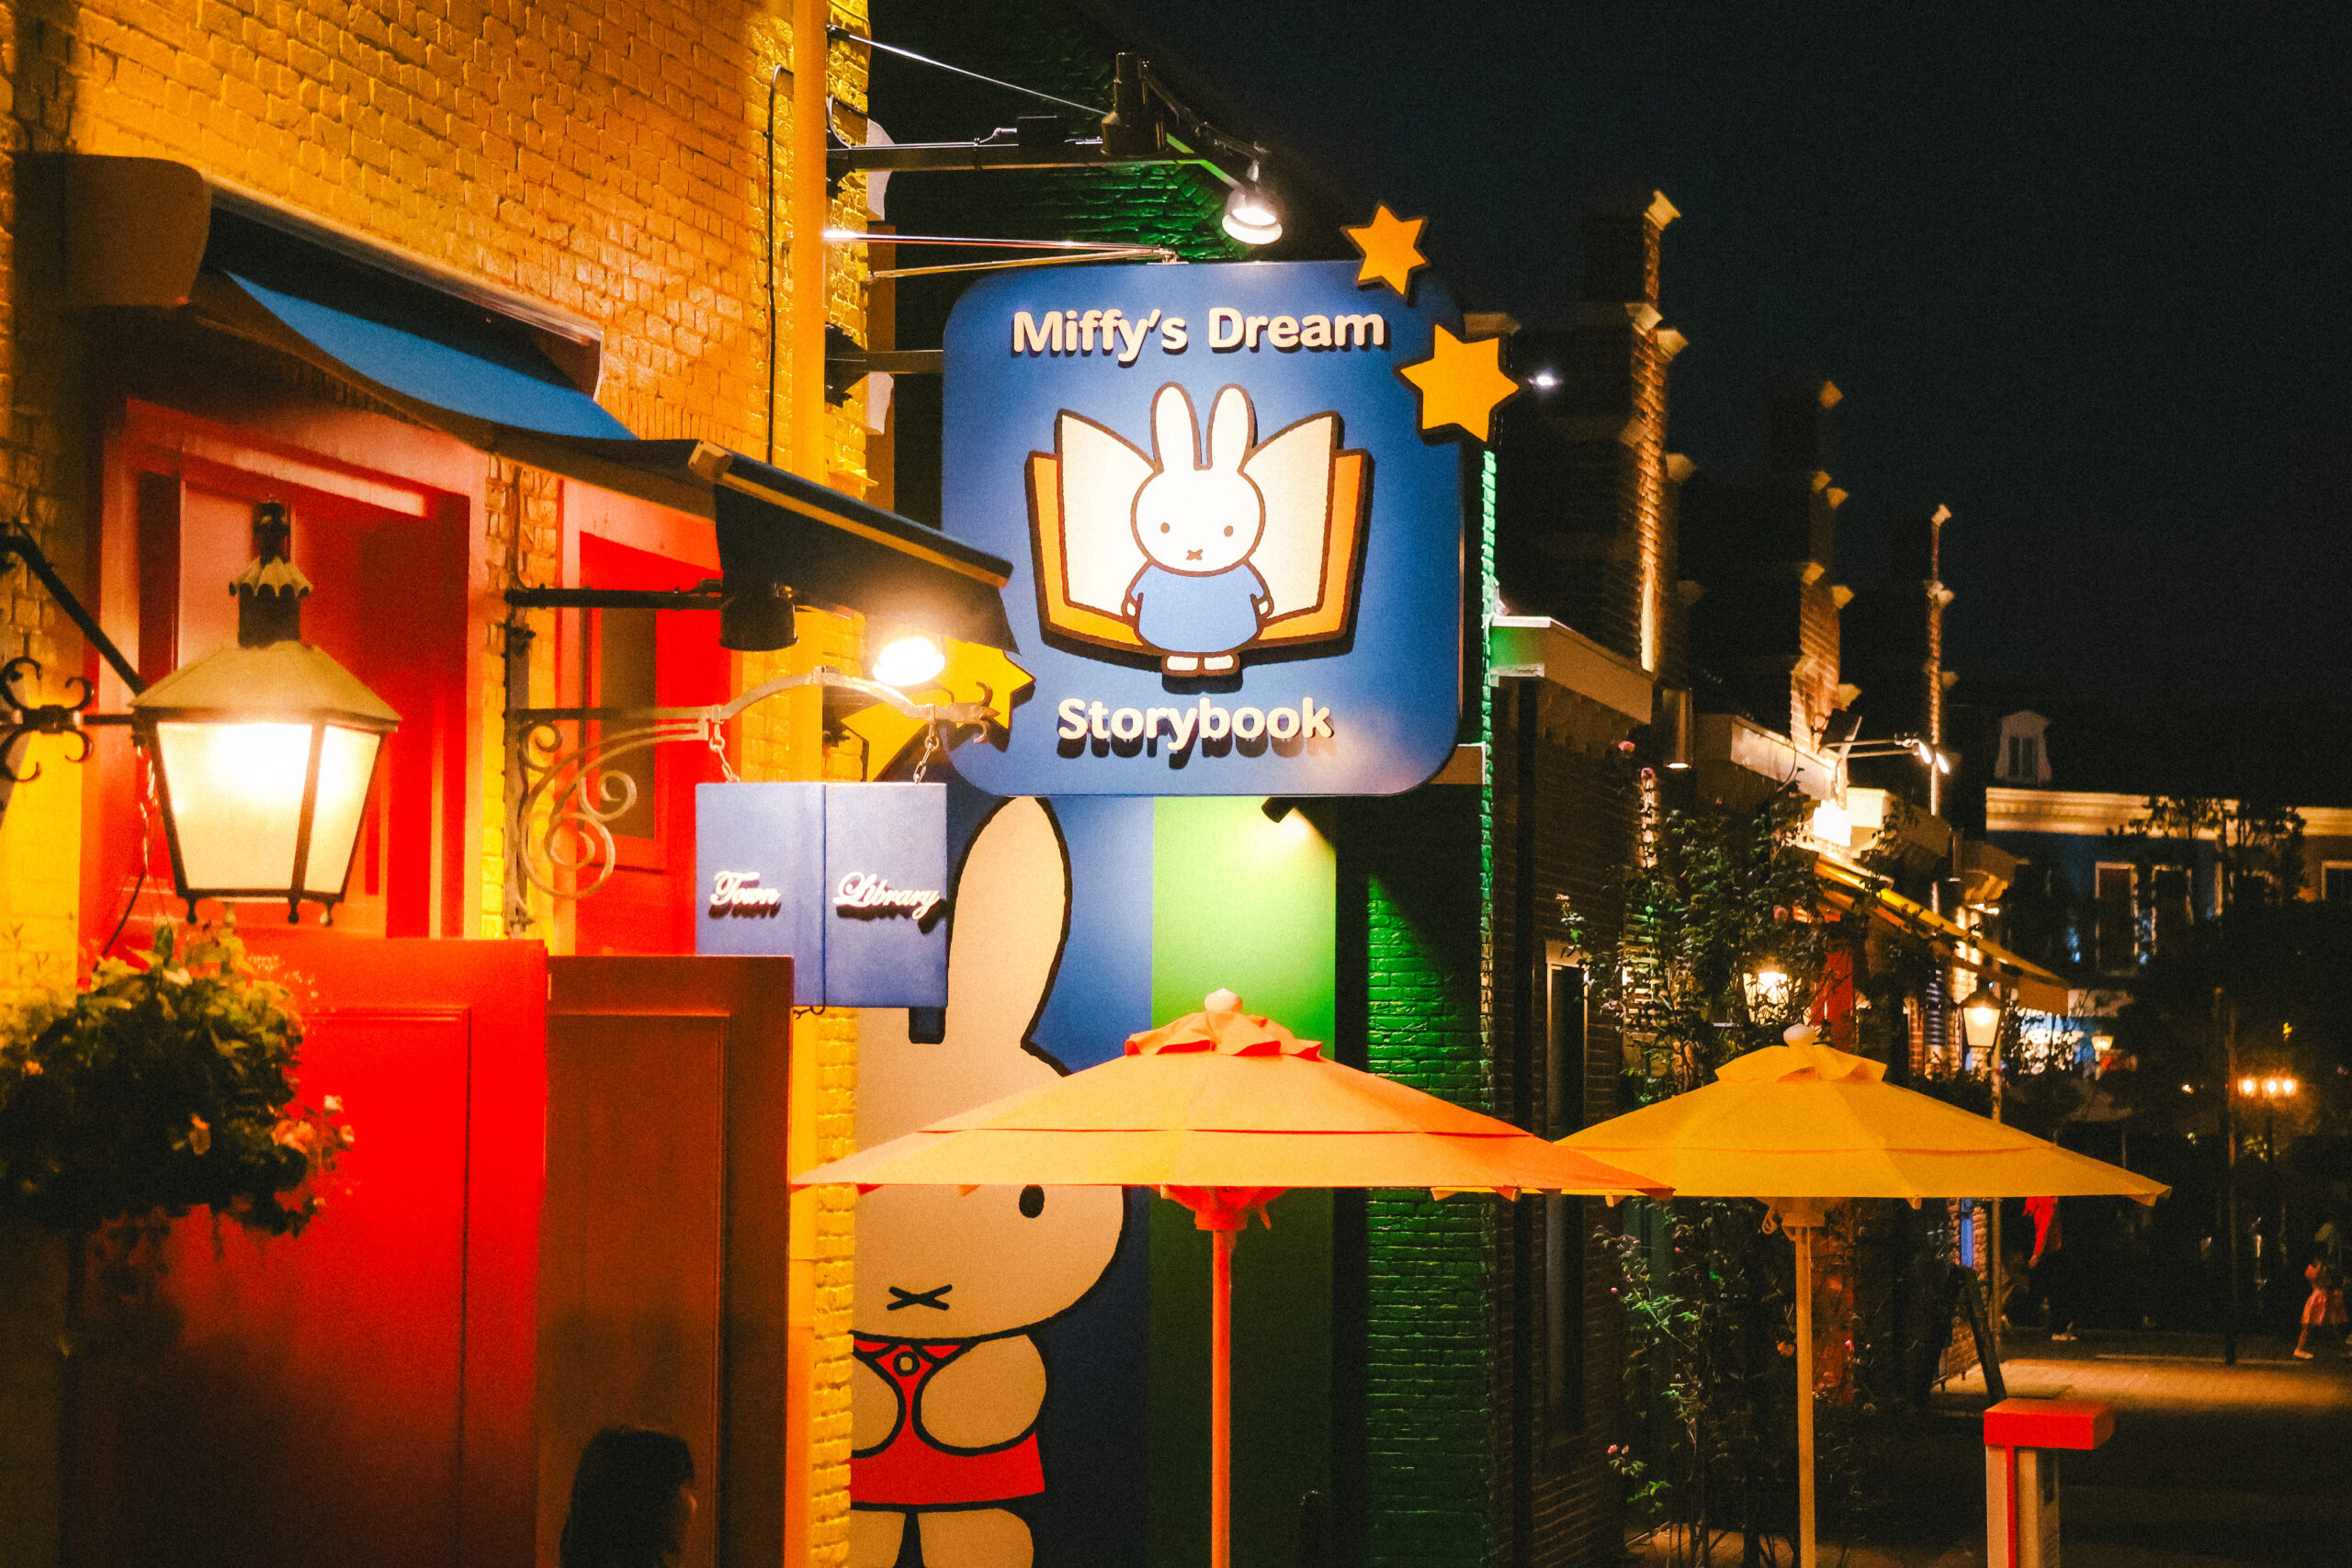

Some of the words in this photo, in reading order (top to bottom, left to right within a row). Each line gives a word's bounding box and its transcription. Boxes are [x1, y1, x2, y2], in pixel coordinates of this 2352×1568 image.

[1012, 308, 1188, 363] Miffy's
[1208, 307, 1385, 350] Dream
[1057, 696, 1335, 751] Storybook
[708, 870, 781, 906] Town
[831, 871, 941, 919] Library
